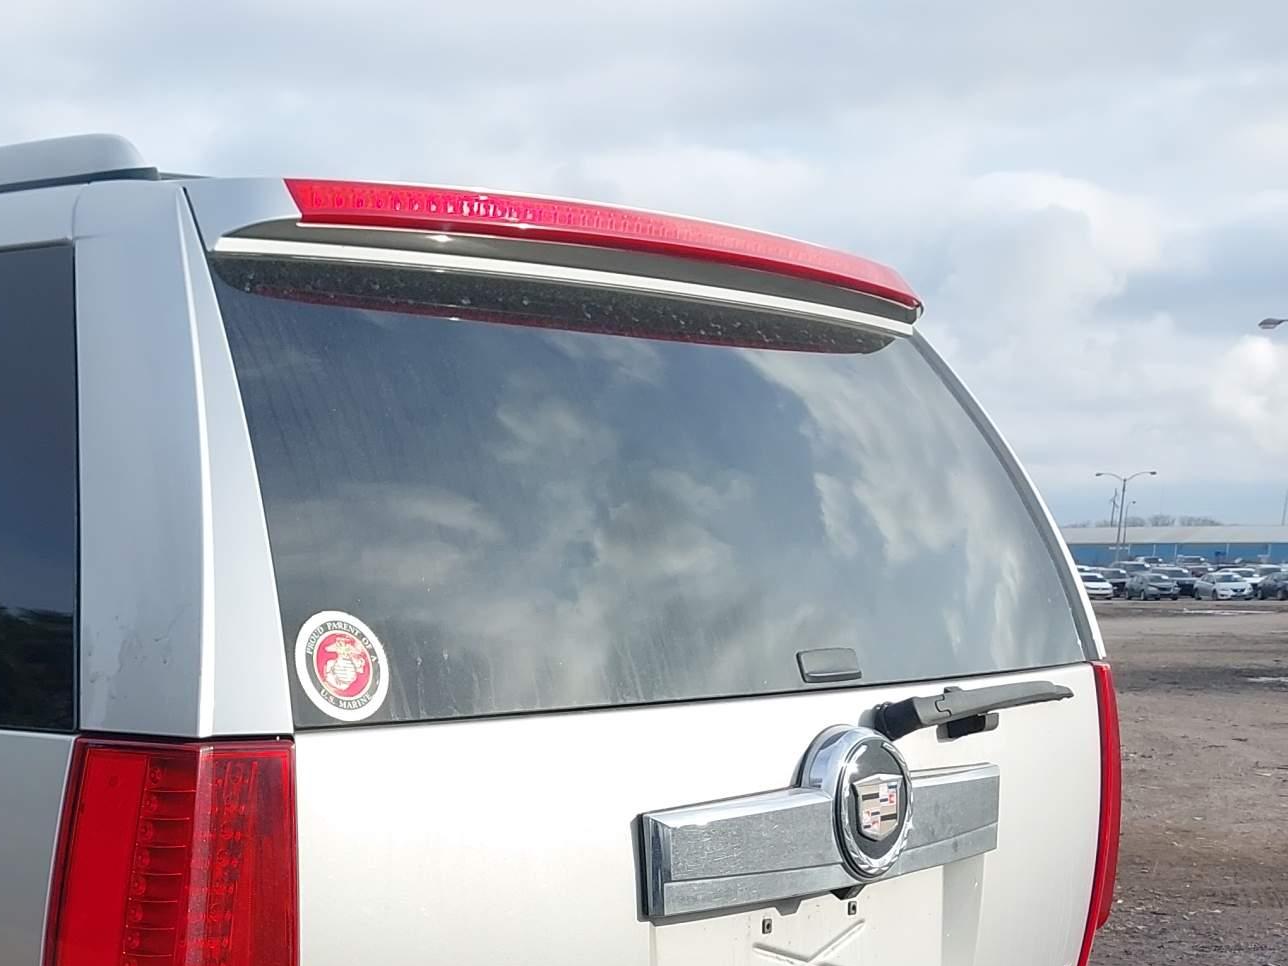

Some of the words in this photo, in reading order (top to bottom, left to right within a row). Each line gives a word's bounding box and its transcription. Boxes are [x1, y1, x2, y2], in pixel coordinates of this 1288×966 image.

[306, 626, 324, 656] PROUD
[326, 621, 361, 636] PARENT
[362, 636, 373, 650] OF
[370, 653, 379, 662] A
[338, 693, 373, 709] MARINE
